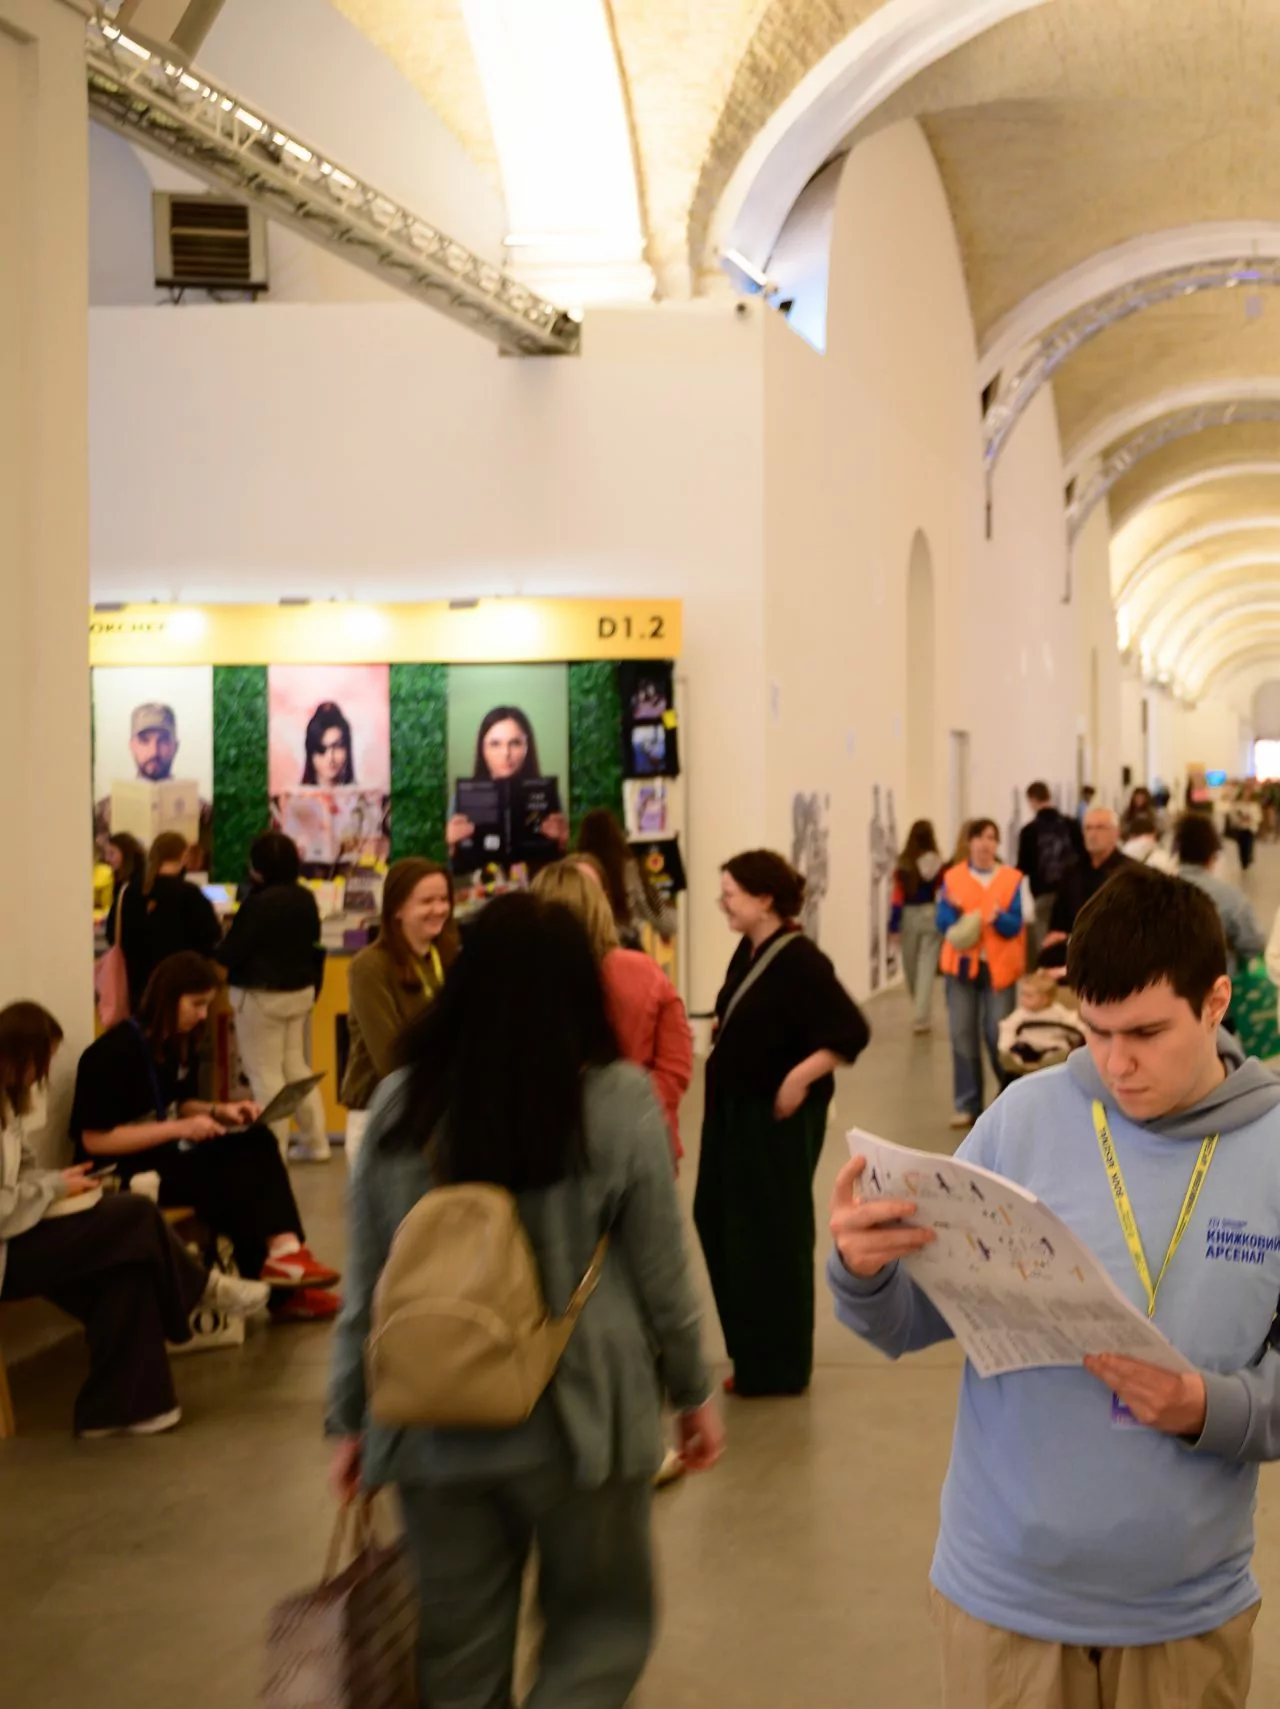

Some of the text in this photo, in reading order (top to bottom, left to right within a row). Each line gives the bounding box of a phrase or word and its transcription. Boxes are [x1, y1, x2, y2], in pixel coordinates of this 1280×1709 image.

[597, 615, 666, 639] D1.2
[1206, 1229, 1280, 1253] КНИЖКОВИЙ
[1205, 1245, 1265, 1265] АРСЕНАЛ
